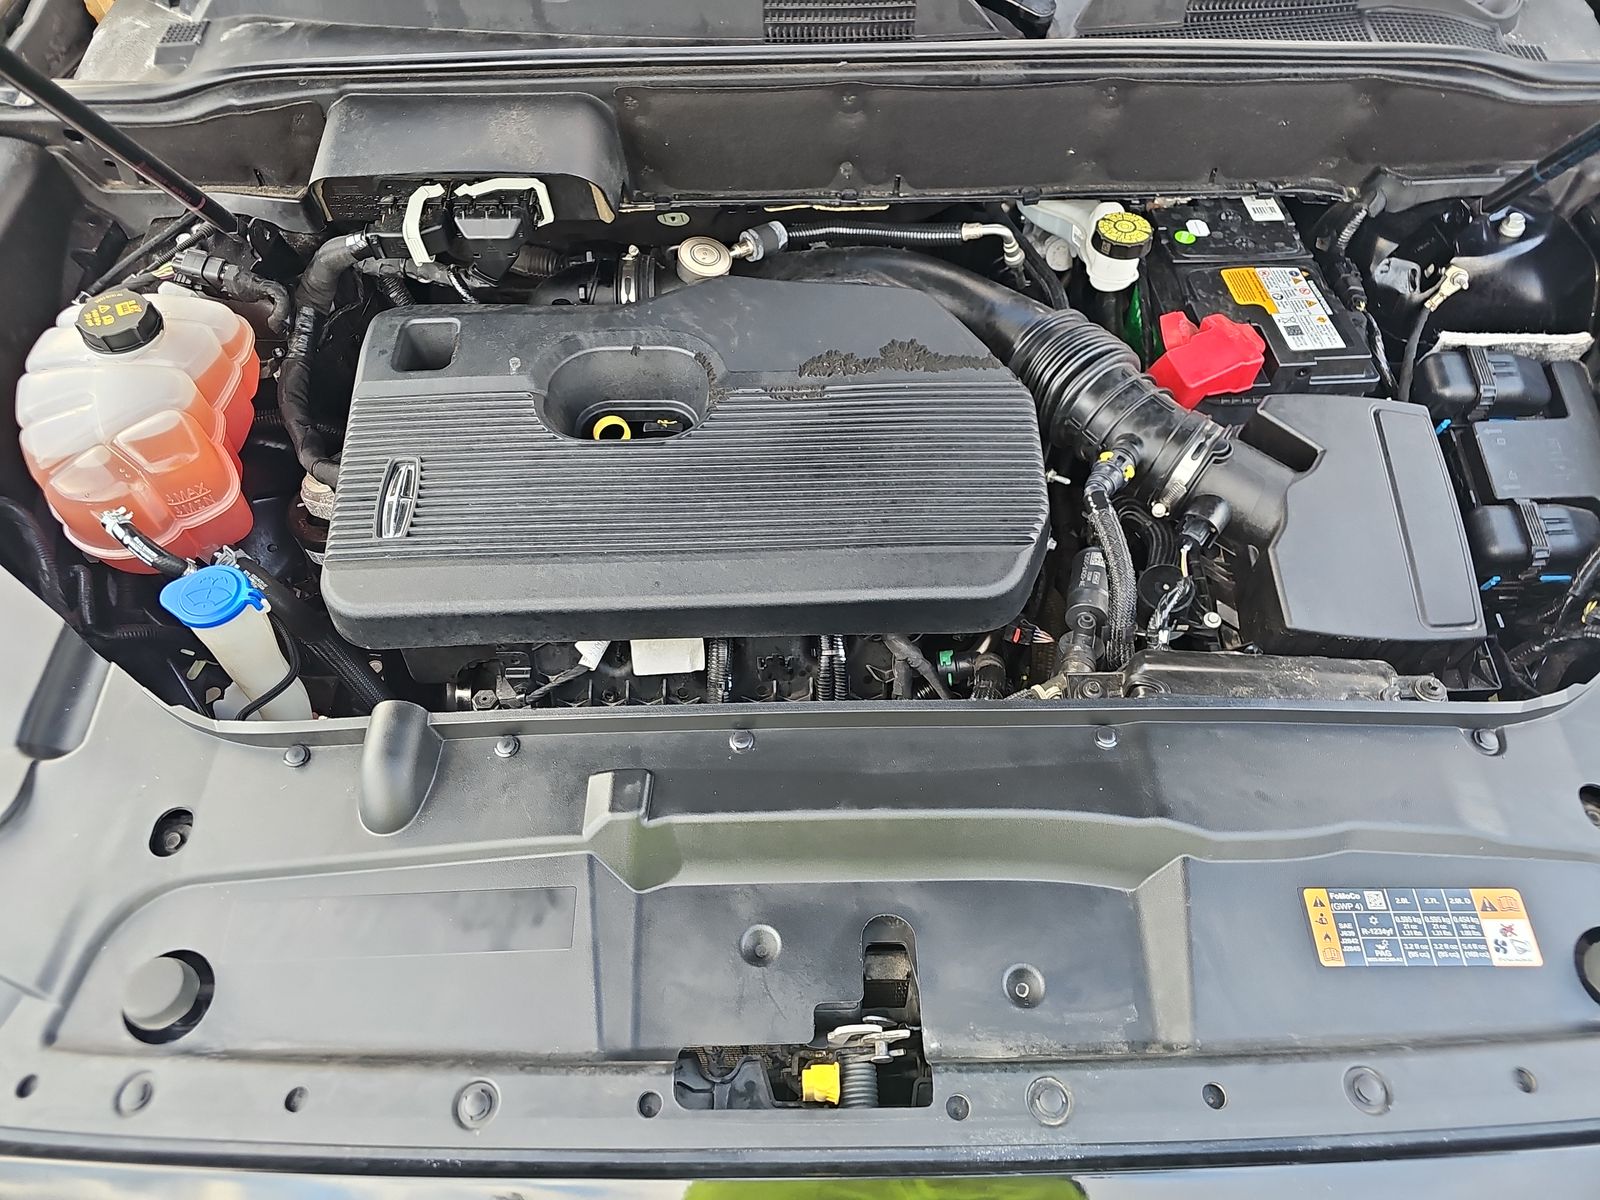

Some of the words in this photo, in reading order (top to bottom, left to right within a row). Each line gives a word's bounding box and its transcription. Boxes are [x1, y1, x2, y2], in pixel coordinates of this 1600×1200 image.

[173, 481, 209, 502] MAX
[1330, 902, 1354, 911] (GWP
[1354, 902, 1364, 911] 4)
[1360, 927, 1394, 936] R-1234yf
